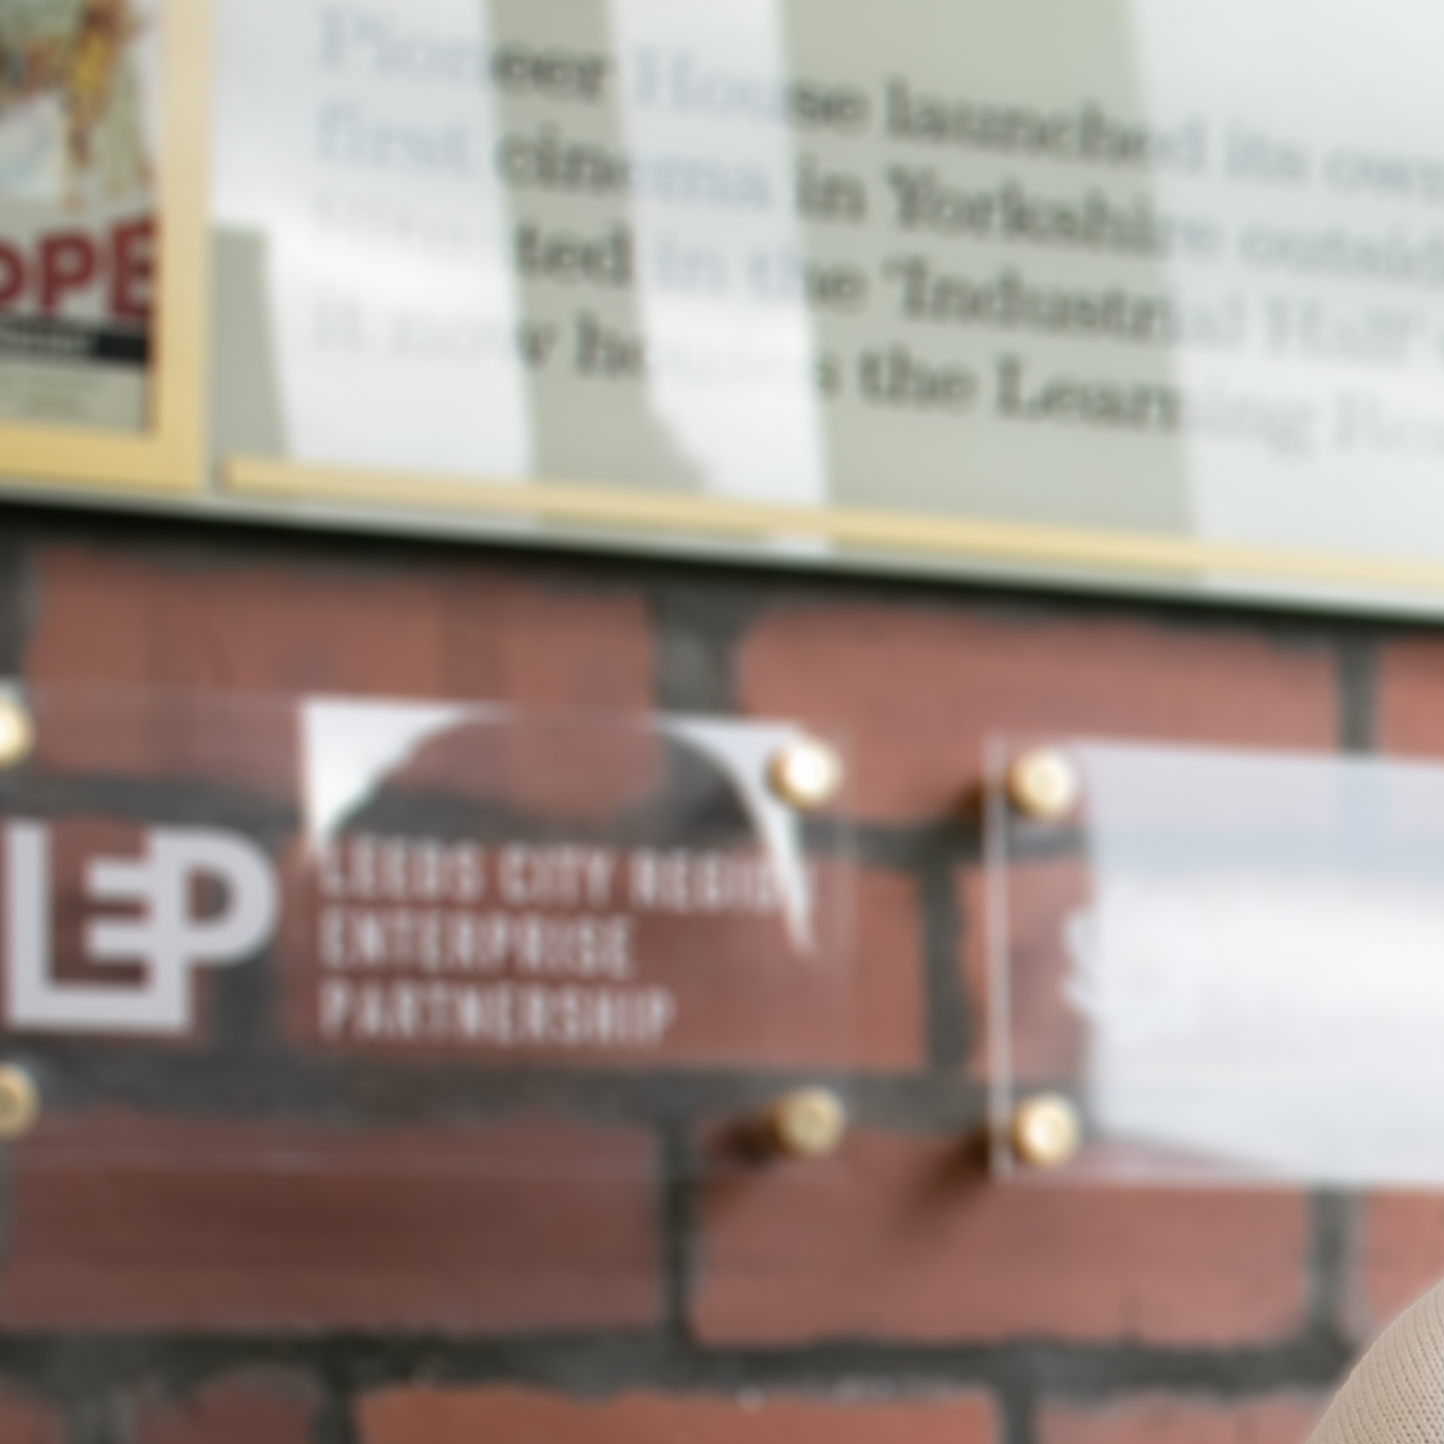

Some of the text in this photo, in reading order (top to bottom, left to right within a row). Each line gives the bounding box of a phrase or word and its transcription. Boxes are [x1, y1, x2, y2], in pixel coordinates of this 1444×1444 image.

[316, 6, 614, 104] Pioneer
[634, 43, 870, 136] House
[888, 76, 1207, 176] launched
[1226, 117, 1310, 185] its
[316, 97, 471, 182] first
[494, 124, 770, 213] cinema
[797, 150, 866, 225] in
[887, 164, 1226, 266] Yorkshire
[745, 243, 869, 315] the
[858, 340, 980, 416] the
[996, 352, 1316, 463] Learning
[317, 834, 483, 898] LEEDS
[498, 841, 616, 904] CITY
[318, 905, 636, 980] ENTERPRISE
[318, 974, 677, 1047] PARTNERSHIP
